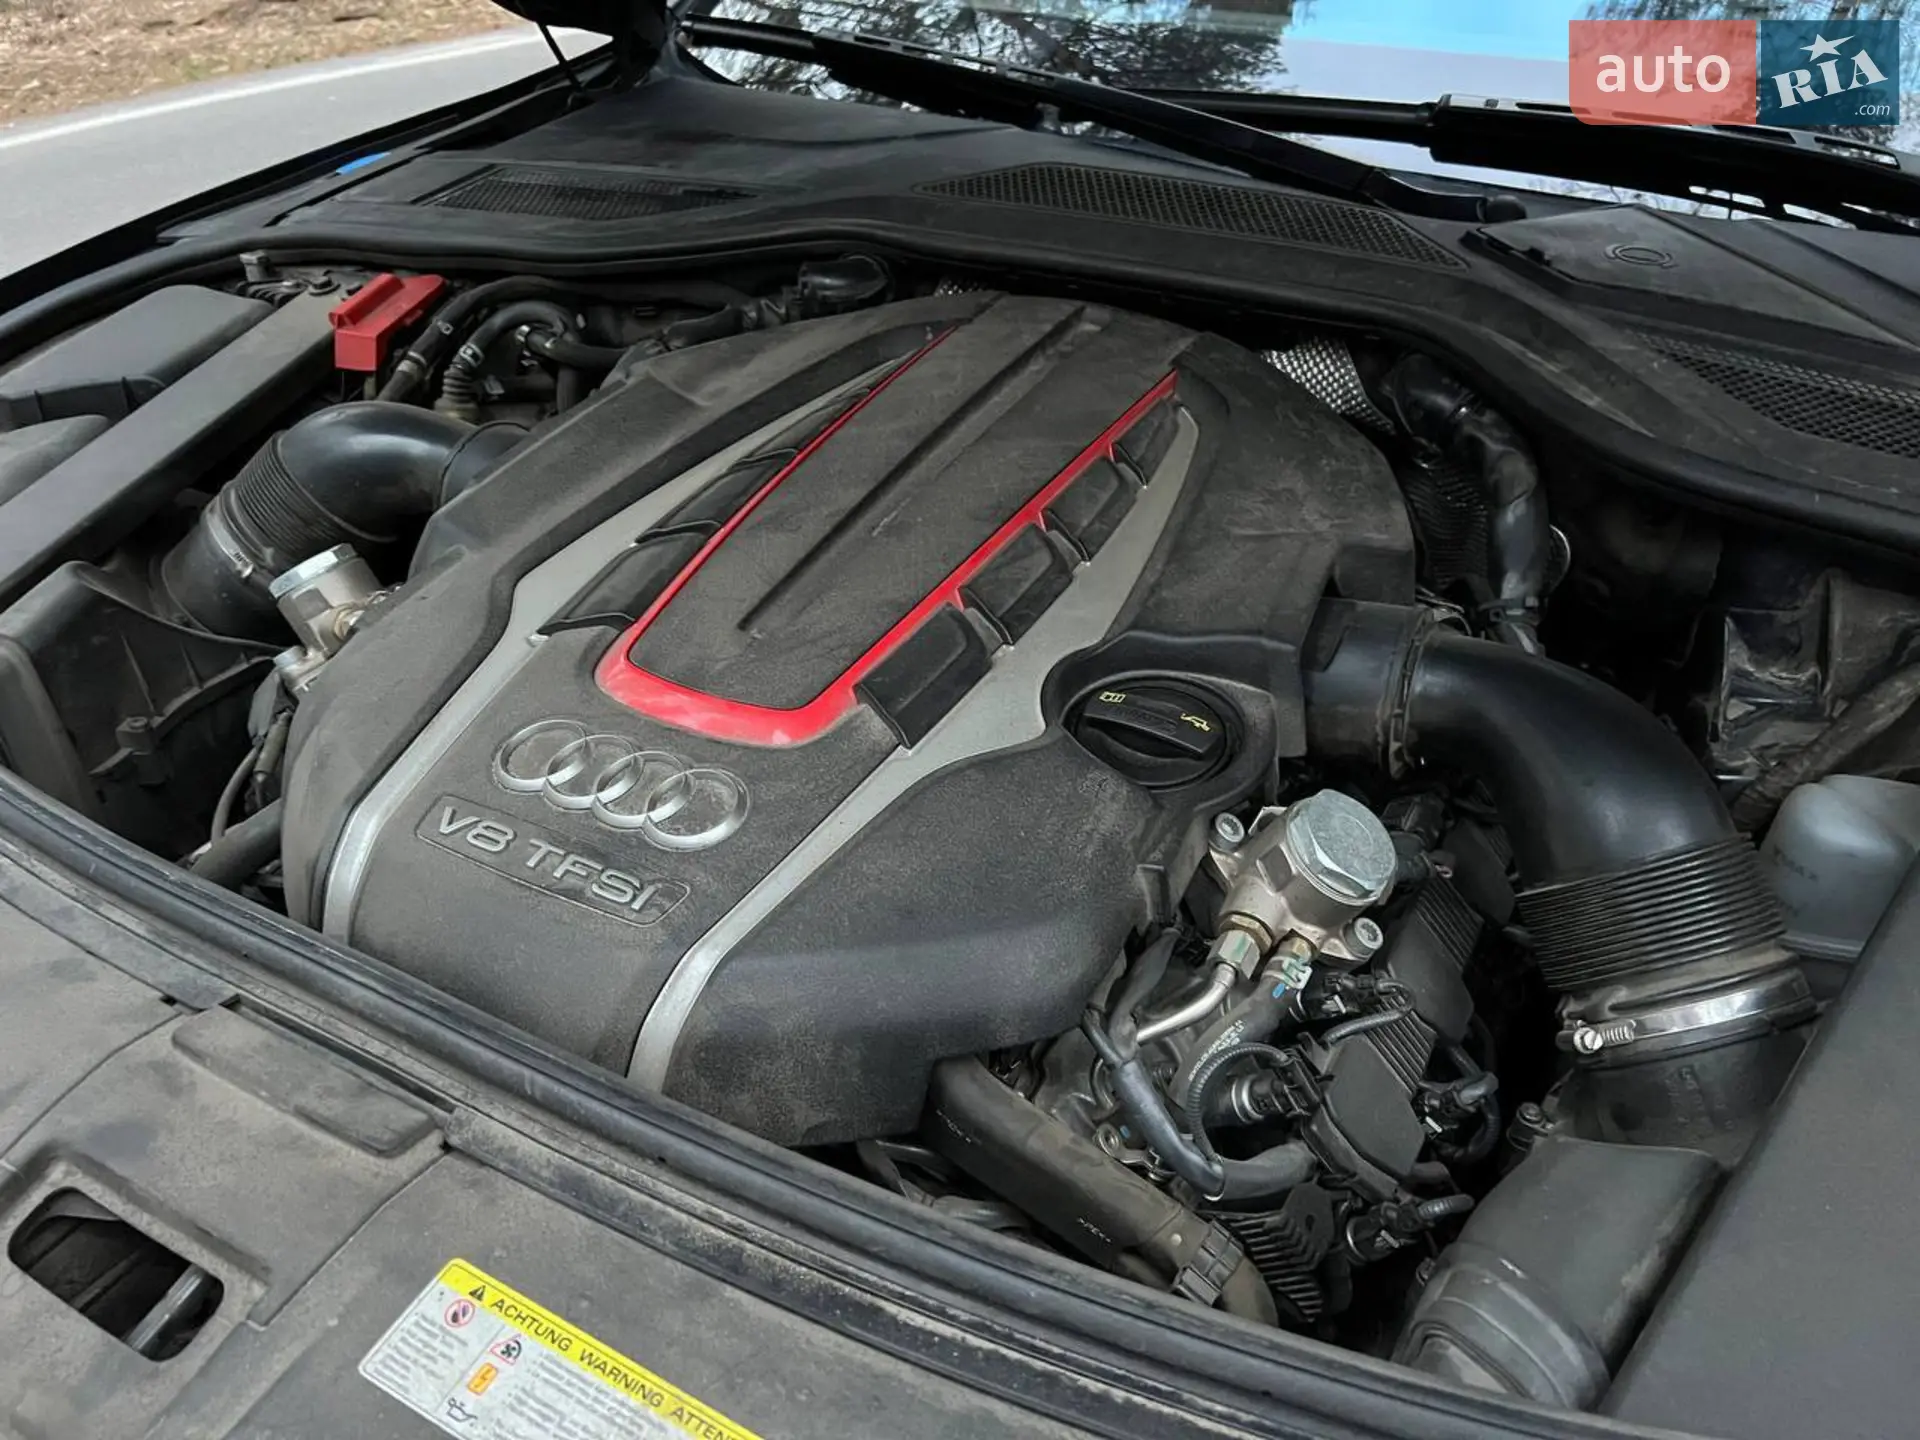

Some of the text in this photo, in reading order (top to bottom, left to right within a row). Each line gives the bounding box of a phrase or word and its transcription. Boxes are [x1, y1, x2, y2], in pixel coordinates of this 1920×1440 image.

[439, 806, 659, 911] V8 TFSI
[490, 1298, 574, 1352] ACHTUNG
[579, 1348, 665, 1408] WARNING
